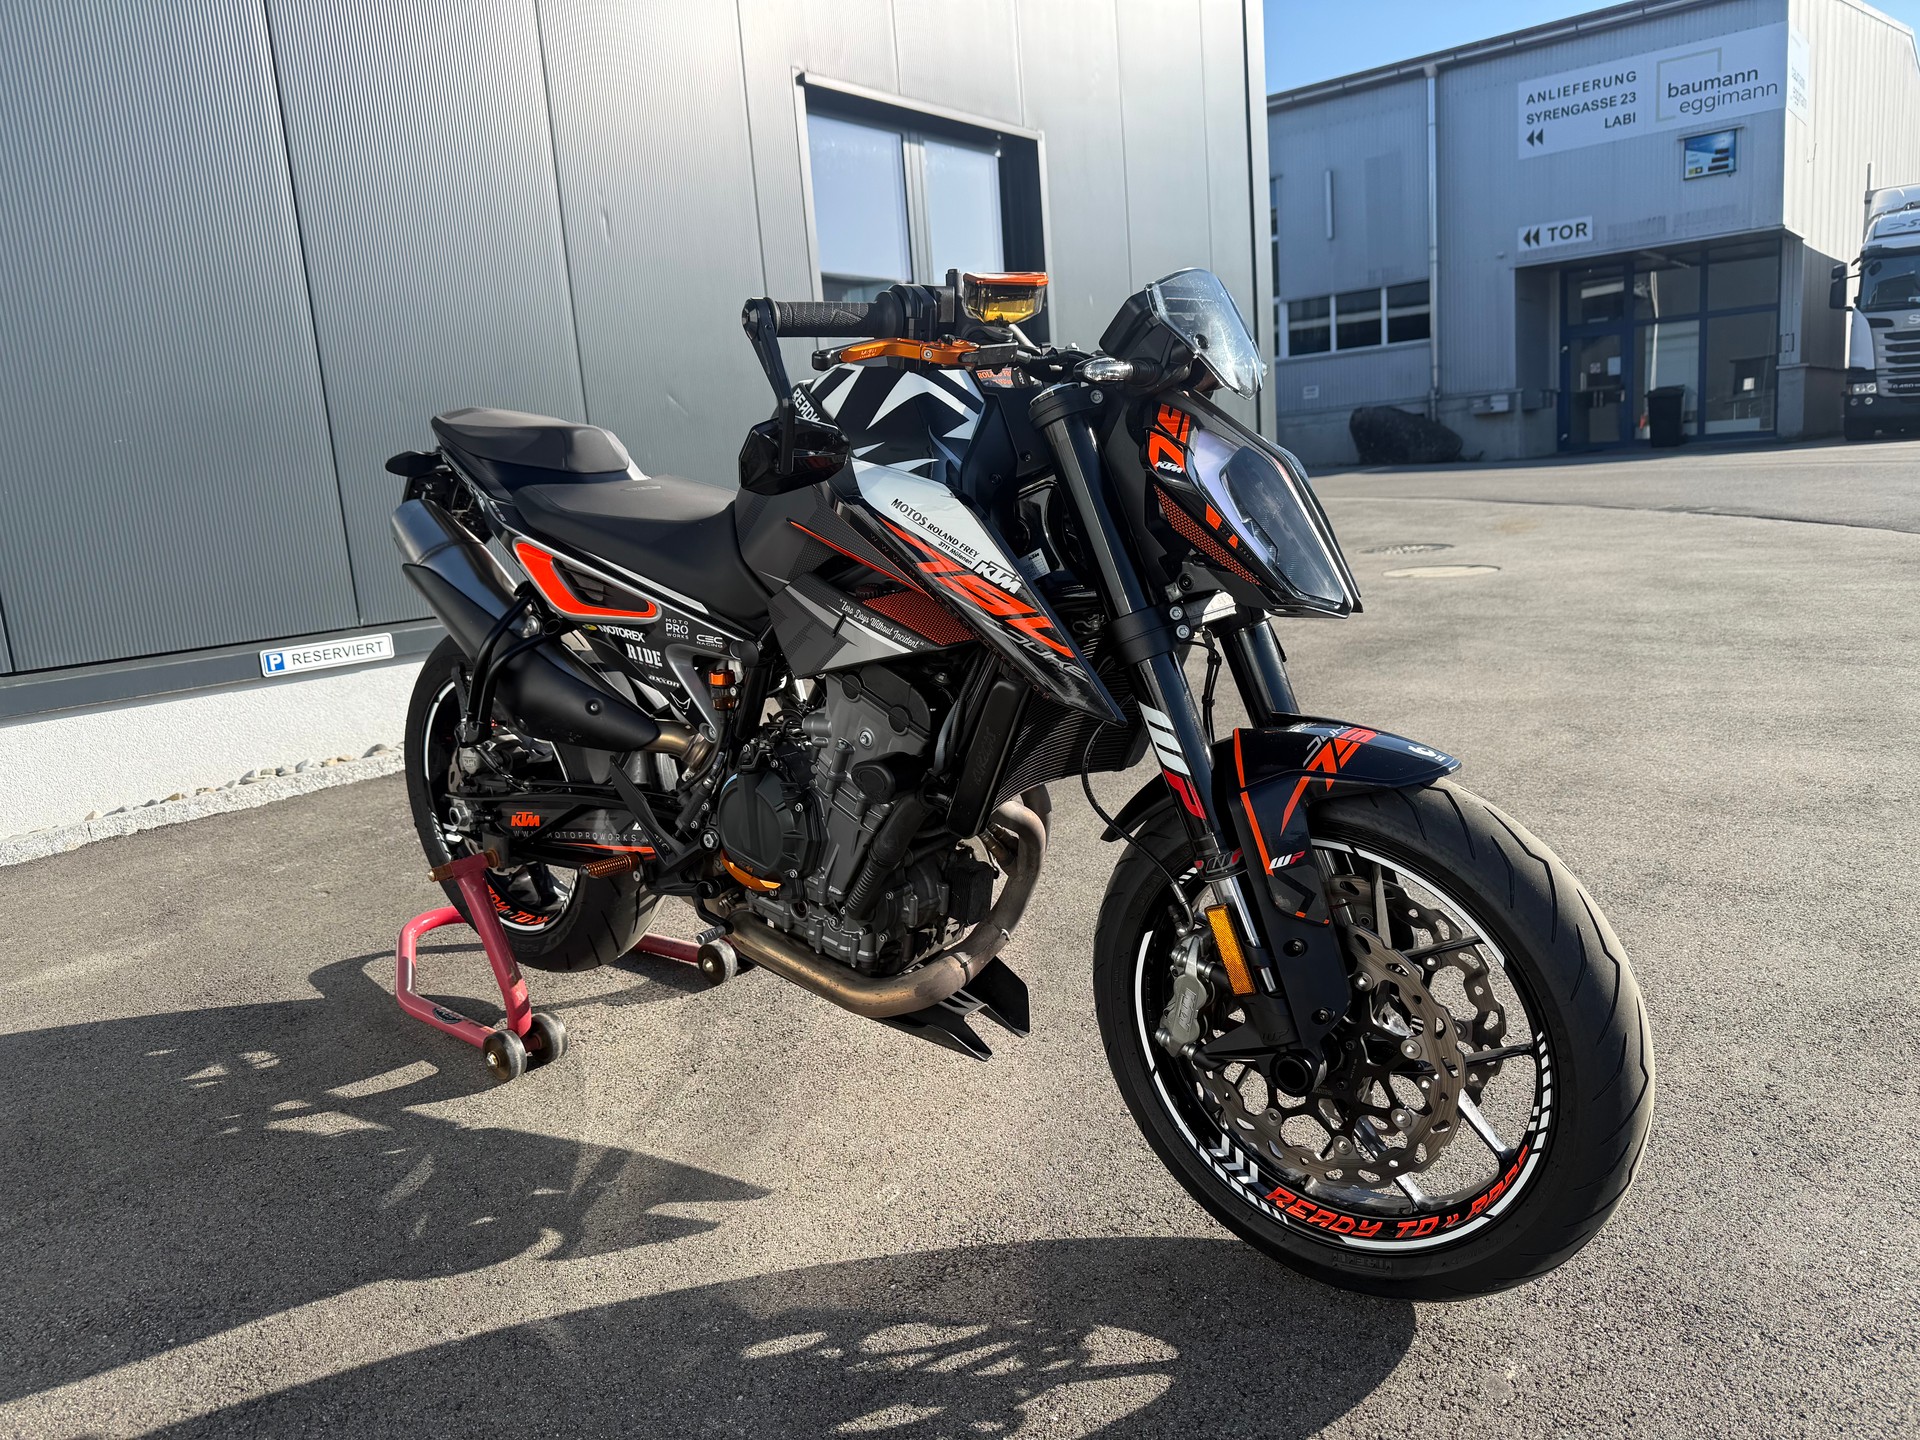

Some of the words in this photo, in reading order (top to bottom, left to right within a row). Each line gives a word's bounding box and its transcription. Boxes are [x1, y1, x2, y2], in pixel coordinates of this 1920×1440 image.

[1526, 70, 1637, 106] ANLIEFERUNG
[1667, 69, 1759, 99] baumann
[1526, 95, 1617, 125] SYRENGASSE
[1620, 91, 1637, 106] 23
[1679, 82, 1779, 116] eggimann
[1604, 112, 1636, 129] LABI
[1547, 222, 1589, 242] TOR
[1155, 461, 1183, 474] KTM
[890, 498, 929, 526] MOTOS
[926, 522, 960, 546] ROLAND
[959, 542, 980, 558] FREY
[938, 541, 951, 551] 3711
[973, 560, 1022, 595] KTM
[665, 618, 689, 626] MOTO
[665, 623, 689, 635] PRO
[597, 624, 646, 643] MOTOREX
[292, 641, 384, 665] RESERVIERT
[625, 643, 663, 668] RIDE
[696, 641, 723, 649] RACING
[1003, 628, 1089, 683] DUKE
[511, 811, 541, 827] KTM
[1269, 850, 1306, 870] WP
[1264, 1186, 1383, 1238] READY
[1395, 1215, 1440, 1239] TO
